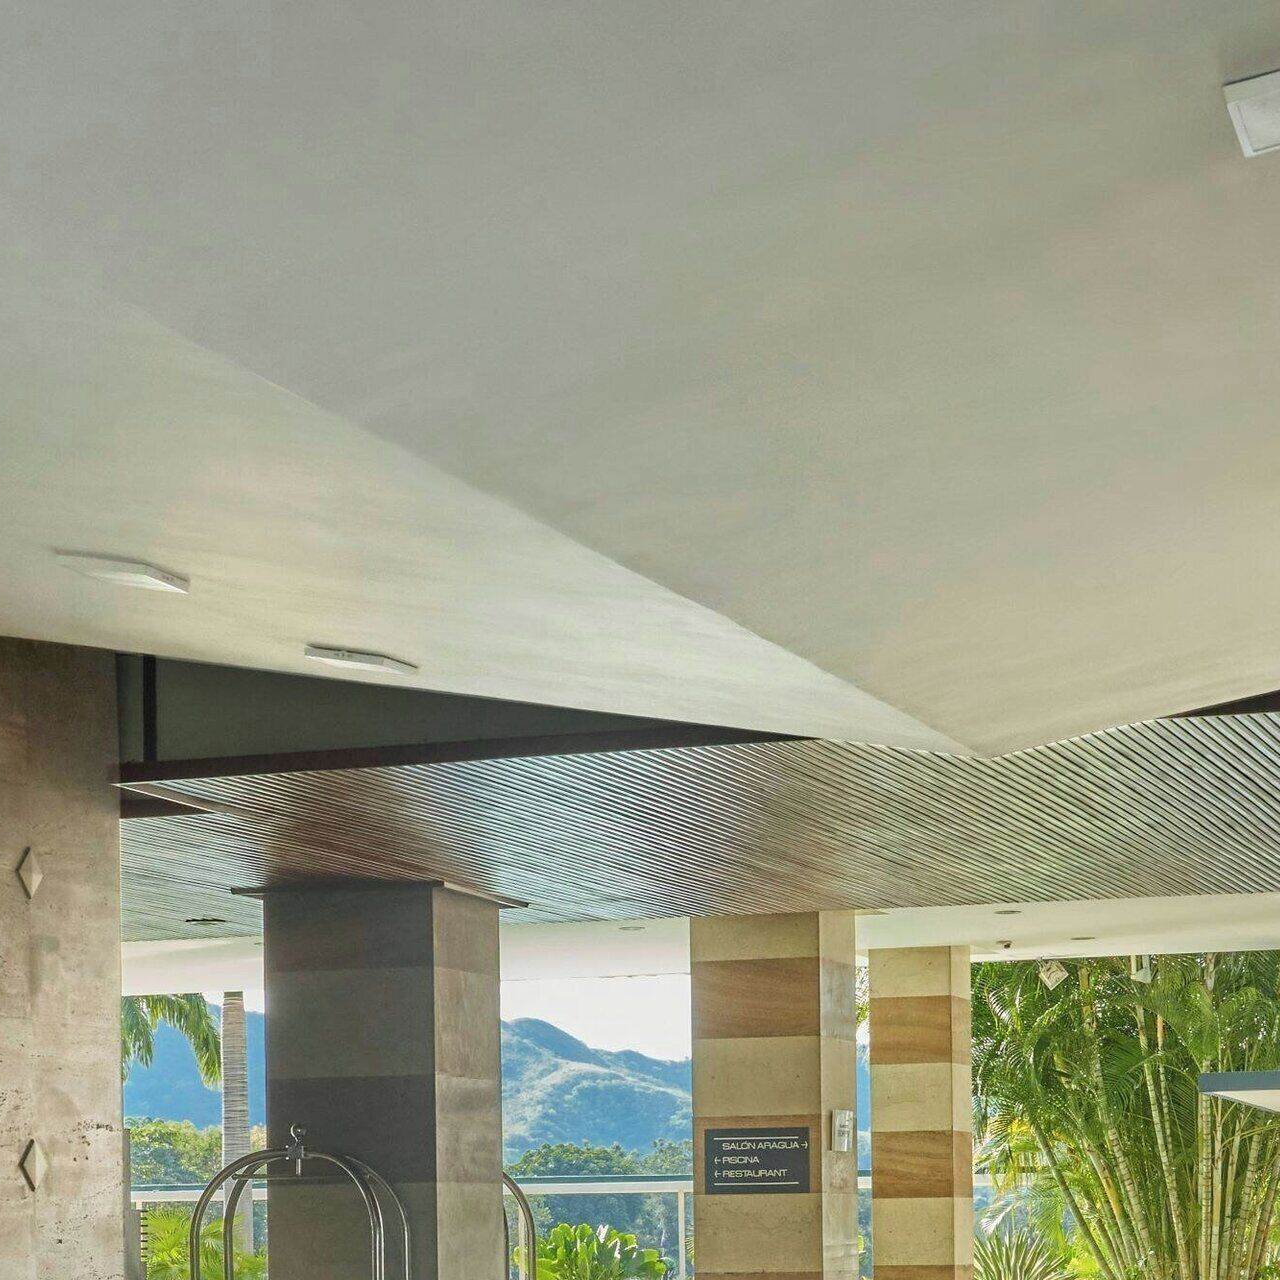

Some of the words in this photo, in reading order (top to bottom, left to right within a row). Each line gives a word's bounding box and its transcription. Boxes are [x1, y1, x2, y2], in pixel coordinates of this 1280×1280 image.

[722, 1140, 756, 1150] SALÓN
[757, 1141, 799, 1149] ARAGUA
[722, 1156, 760, 1164] PISCINA
[722, 1169, 787, 1177] RESTAURANT
